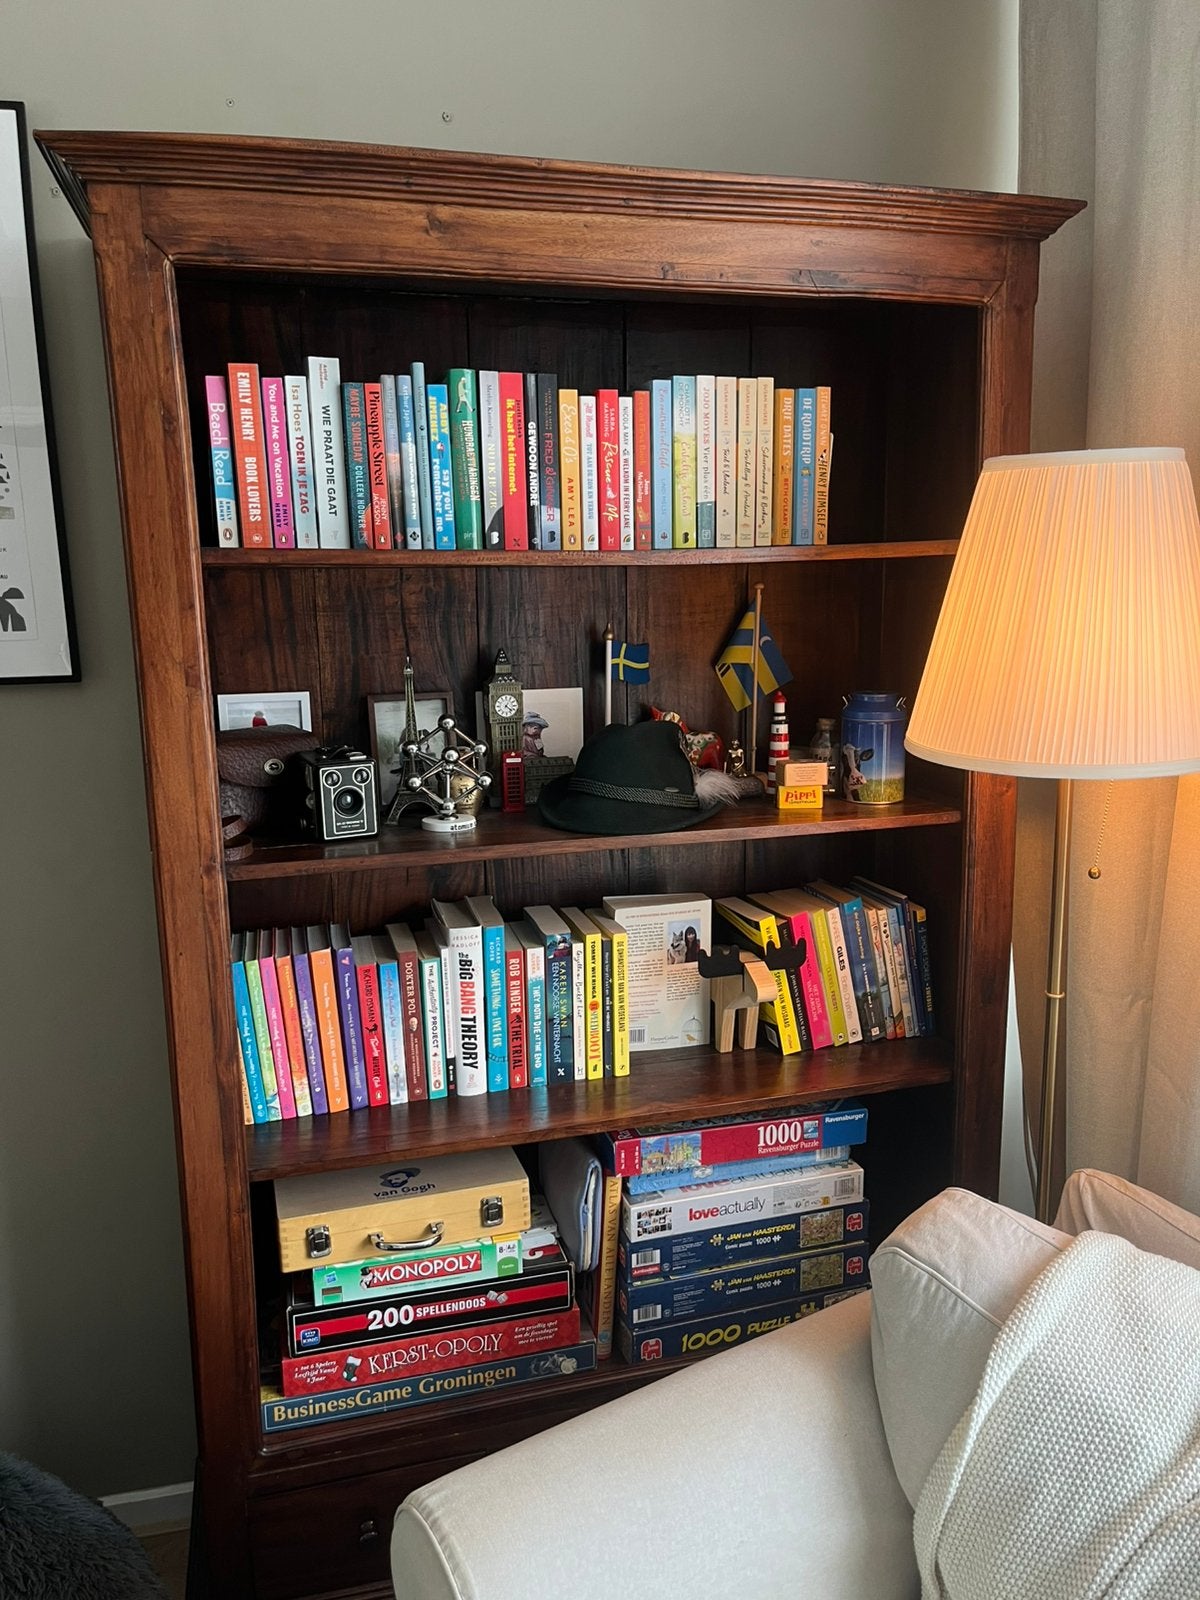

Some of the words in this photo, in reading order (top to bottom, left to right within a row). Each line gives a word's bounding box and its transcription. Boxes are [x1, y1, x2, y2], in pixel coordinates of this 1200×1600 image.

[237, 372, 252, 404] EMILY
[269, 384, 279, 403] You
[291, 384, 301, 400] Isa
[271, 405, 281, 423] and
[292, 403, 303, 432] Hoes
[321, 405, 331, 425] WIE
[350, 389, 361, 418] MAYBE
[506, 399, 516, 409] ik
[783, 397, 792, 421] DRIE
[803, 398, 813, 410] DE
[210, 403, 227, 444] Beach
[240, 408, 255, 441] HENRY
[368, 391, 381, 449] Pineapple
[440, 403, 449, 435] ABBY
[507, 411, 517, 433] haat
[560, 403, 577, 434] Exes
[603, 402, 611, 438] MANNING
[622, 406, 630, 430] NICOLA
[703, 412, 711, 445] MOYES
[272, 425, 281, 440] Me
[323, 430, 334, 463] PRAAT
[352, 421, 364, 463] SOMEDAY
[507, 435, 517, 452] het
[527, 421, 537, 470] GEWOON
[782, 425, 792, 456] DATES
[800, 413, 812, 464] ROADTRIP
[273, 443, 281, 455] on
[295, 435, 306, 464] TOEN
[544, 433, 554, 464] FRED
[602, 441, 619, 483] Rescue
[703, 447, 711, 464] Vier
[213, 450, 230, 485] Read
[244, 457, 257, 483] BOOK
[274, 457, 285, 498] Vacation
[297, 467, 307, 477] IK
[326, 467, 336, 485] DIE
[372, 451, 385, 486] Street
[442, 470, 451, 487] say
[508, 454, 518, 496] internet.
[702, 466, 711, 484] plus
[817, 460, 828, 488] HENRY
[298, 479, 308, 490] JE
[354, 466, 365, 498] COLLEEN
[432, 458, 443, 514] remember
[529, 472, 540, 507] ANDRÉ
[566, 478, 575, 501] AMY
[802, 479, 810, 497] BETH
[247, 486, 262, 522] LOVERS
[299, 492, 310, 514] ZAG
[326, 488, 338, 516] GAAT
[357, 500, 367, 528] HOOVER
[373, 493, 381, 525] JACKSON
[443, 491, 454, 521] you'll
[602, 503, 619, 522] Me
[817, 491, 828, 528] HIMSELF
[436, 517, 444, 532] me
[784, 789, 817, 803] Pippi
[458, 952, 469, 960] the
[508, 958, 521, 976] ROB
[552, 962, 560, 977] EEN
[837, 946, 846, 971] GILES
[362, 968, 375, 997] RICHARD
[404, 962, 414, 998] DOKTER
[490, 968, 502, 1009] SOMETHING
[560, 961, 568, 994] KAREN
[407, 999, 416, 1016] POL
[460, 981, 477, 1015] BANG
[510, 980, 522, 1014] RINDER
[533, 985, 541, 1003] THEY
[552, 978, 560, 1011] NOORSE
[774, 972, 784, 993] SPOREN
[781, 1004, 790, 1029] MISDAAD
[790, 974, 799, 997] JOHANN
[795, 998, 805, 1025] SEBASTIAN
[366, 997, 378, 1023] OSMAN
[533, 1003, 541, 1020] BOTH
[560, 999, 568, 1028] SWAN
[618, 1005, 626, 1033] NEDERLAND
[431, 1016, 439, 1048] PROJECT
[492, 1017, 502, 1034] LIVE
[511, 1025, 522, 1041] THE
[533, 1021, 542, 1034] DIE
[553, 1012, 562, 1063] WINTERNACHT
[461, 1016, 478, 1070] THEORY
[493, 1034, 502, 1048] FOR
[371, 1056, 381, 1078] MURDER
[512, 1044, 523, 1070] TRIAL
[534, 1053, 543, 1069] END
[825, 1112, 866, 1124] Ravensburger
[757, 1121, 802, 1147] 1000
[758, 1144, 798, 1155] Ravensburger
[800, 1140, 819, 1151] Puzzle
[374, 1189, 398, 1197] van
[401, 1183, 436, 1194] Gogh
[608, 1180, 619, 1215] ATLAS
[606, 1220, 618, 1241] VAN
[727, 1233, 743, 1243] JAN
[753, 1223, 796, 1237] HAASTEREN
[756, 1237, 772, 1246] 1000
[373, 1253, 479, 1283] MONOPOLY
[604, 1246, 616, 1275] ALLE
[728, 1277, 744, 1287] JAN
[754, 1268, 796, 1282] HAASTEREN
[757, 1281, 772, 1290] 1000
[367, 1304, 414, 1330] 200
[416, 1297, 486, 1318] SPELLENDOOS
[601, 1277, 614, 1326] LANDEN
[681, 1324, 742, 1354] 1000
[747, 1315, 791, 1337] PUZZLE
[315, 1361, 336, 1370] Spelers
[367, 1333, 504, 1376] KERST-OPOLY
[273, 1386, 413, 1423] BusinessGame
[419, 1364, 517, 1396] Groningen
